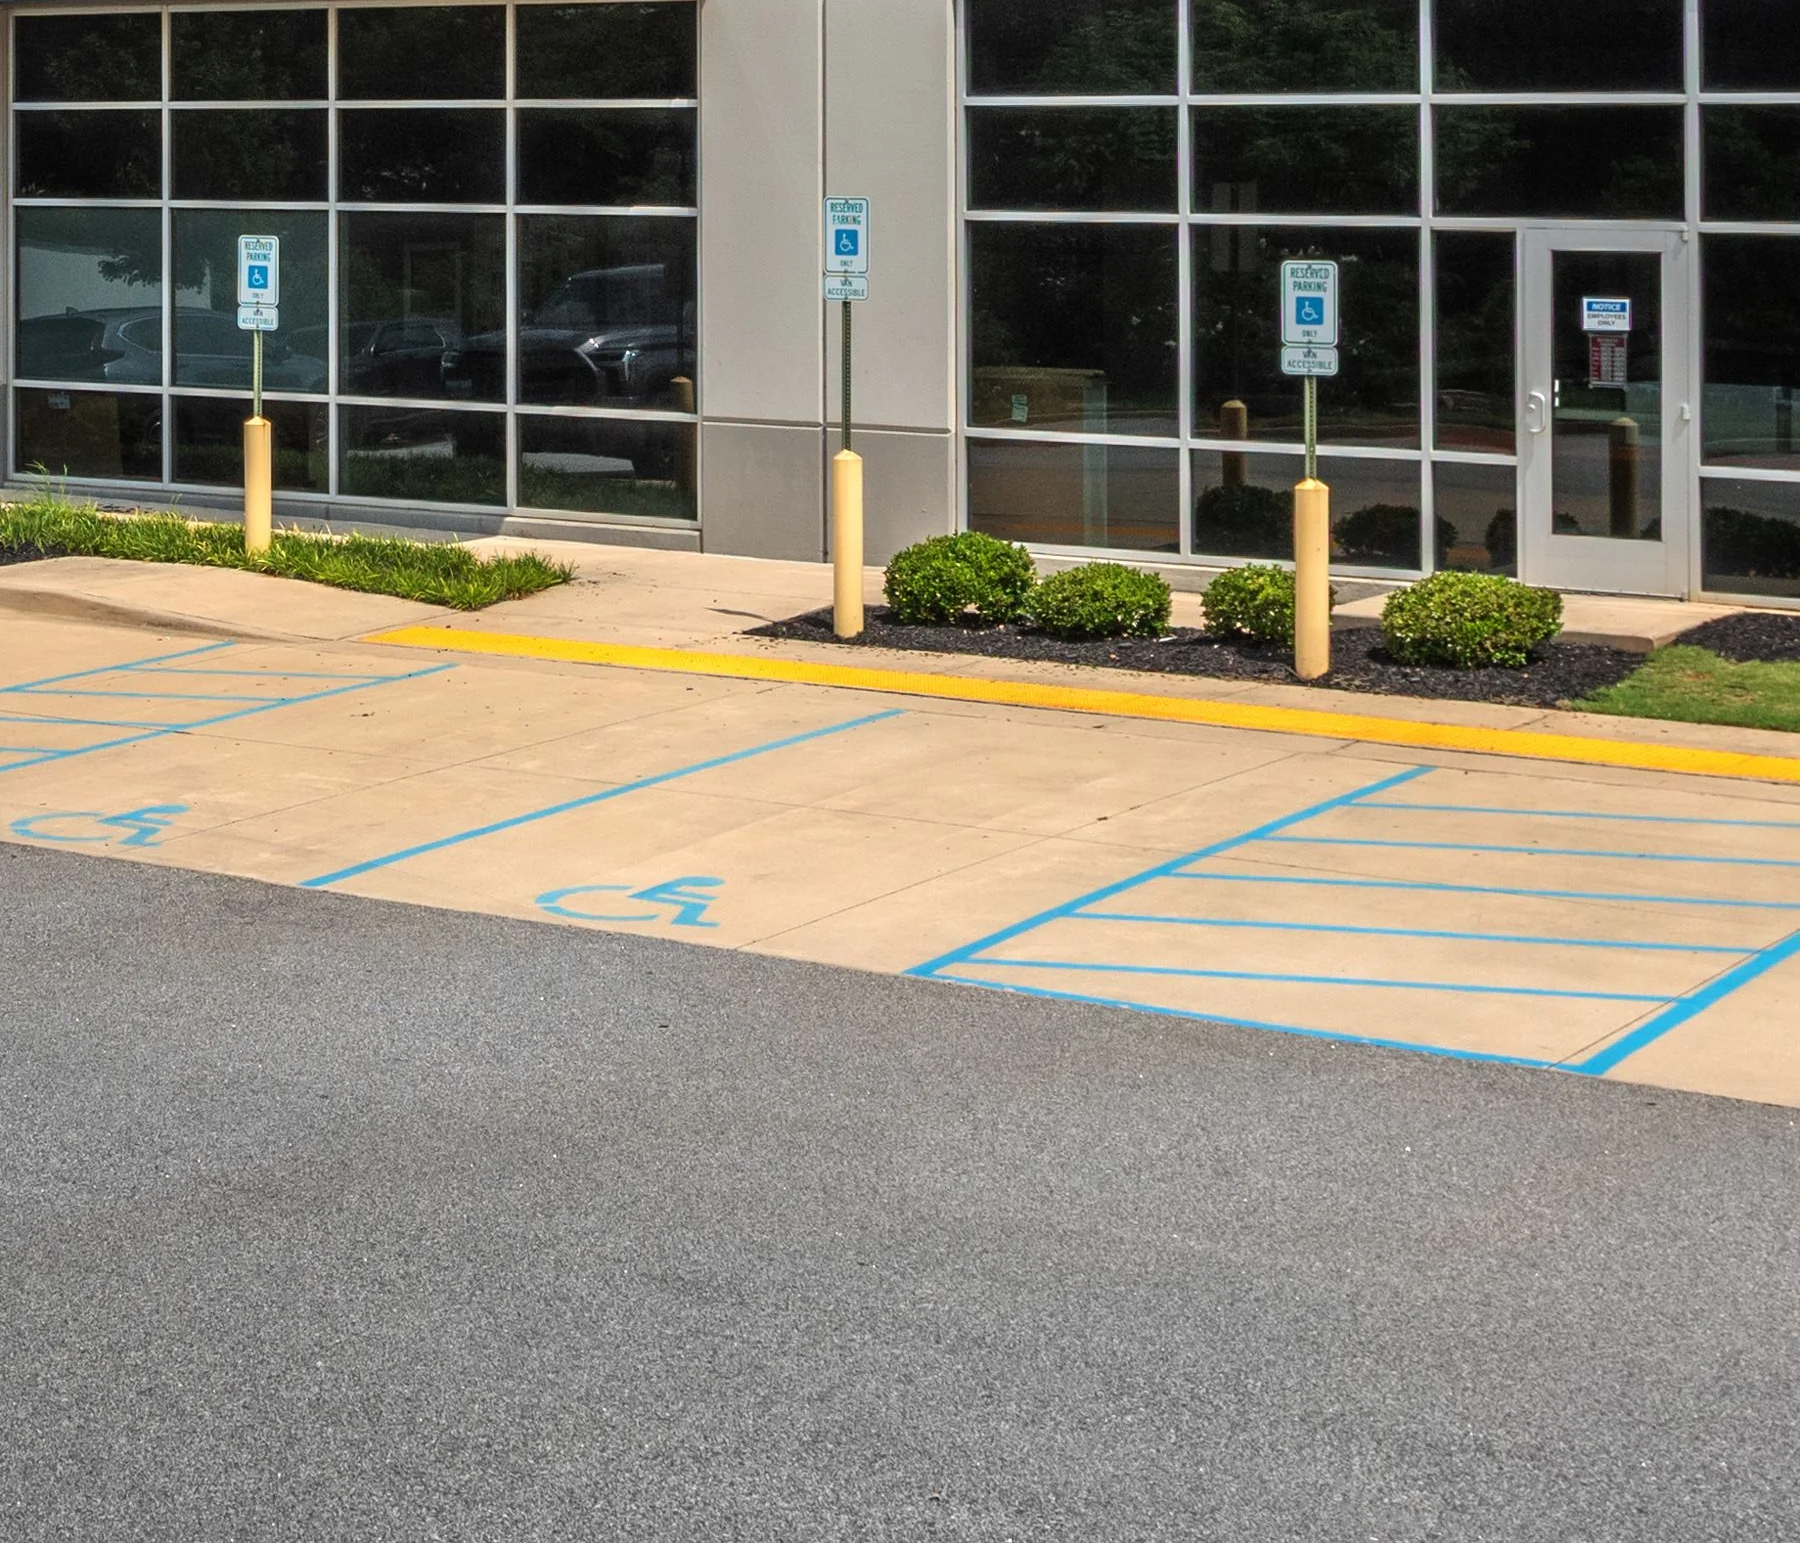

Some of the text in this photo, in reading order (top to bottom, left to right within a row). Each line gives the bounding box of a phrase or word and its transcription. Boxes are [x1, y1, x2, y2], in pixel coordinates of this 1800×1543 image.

[830, 202, 864, 214] RESERVED
[832, 214, 862, 225] PARKING
[245, 240, 273, 251] RESERVED
[246, 252, 271, 262] PARKING
[840, 259, 853, 267] ONLY
[1290, 267, 1330, 279] RESERVED
[840, 279, 853, 287] VAN
[1293, 281, 1327, 293] PARKING
[827, 287, 865, 297] ACCESSIBLE
[1591, 303, 1622, 311] NOTICE
[241, 317, 274, 326] ACCESSIBLE
[1302, 330, 1317, 338] ONLY
[1302, 351, 1317, 359] VAN
[1287, 360, 1332, 370] ACCESSIBLE
